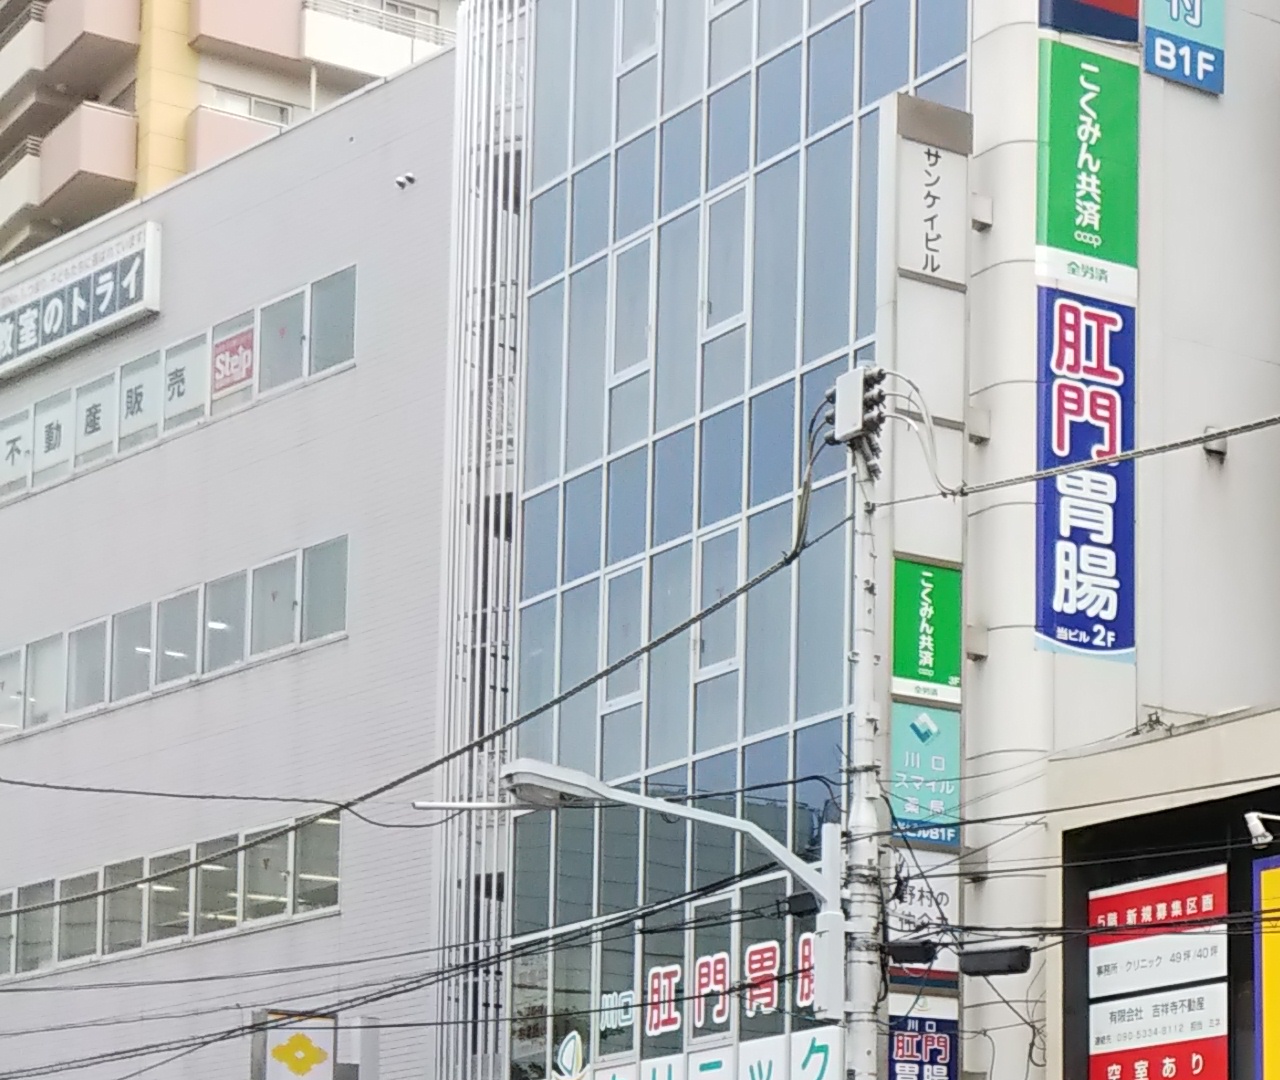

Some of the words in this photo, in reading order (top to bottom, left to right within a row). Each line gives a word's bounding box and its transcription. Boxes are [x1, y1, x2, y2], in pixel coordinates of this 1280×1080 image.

[1154, 37, 1215, 81] B1F
[1074, 62, 1102, 231] こくみん共済
[922, 148, 942, 273] サンケイビル
[1066, 260, 1109, 285] 全労済
[1051, 298, 1123, 621] 肛門胃腸
[917, 571, 935, 668] こくみん共済
[905, 751, 945, 771] 川口
[896, 773, 955, 795] スマイル
[904, 796, 945, 815] 薬局
[1126, 894, 1214, 926] 新規募集区画
[1125, 955, 1162, 972] クリニック
[601, 990, 635, 1031] 川口
[1109, 1007, 1143, 1025] 有限会社
[1152, 996, 1205, 1018] 吉祥寺不動産
[907, 1020, 936, 1032] 川口
[893, 1033, 950, 1063] 肛門
